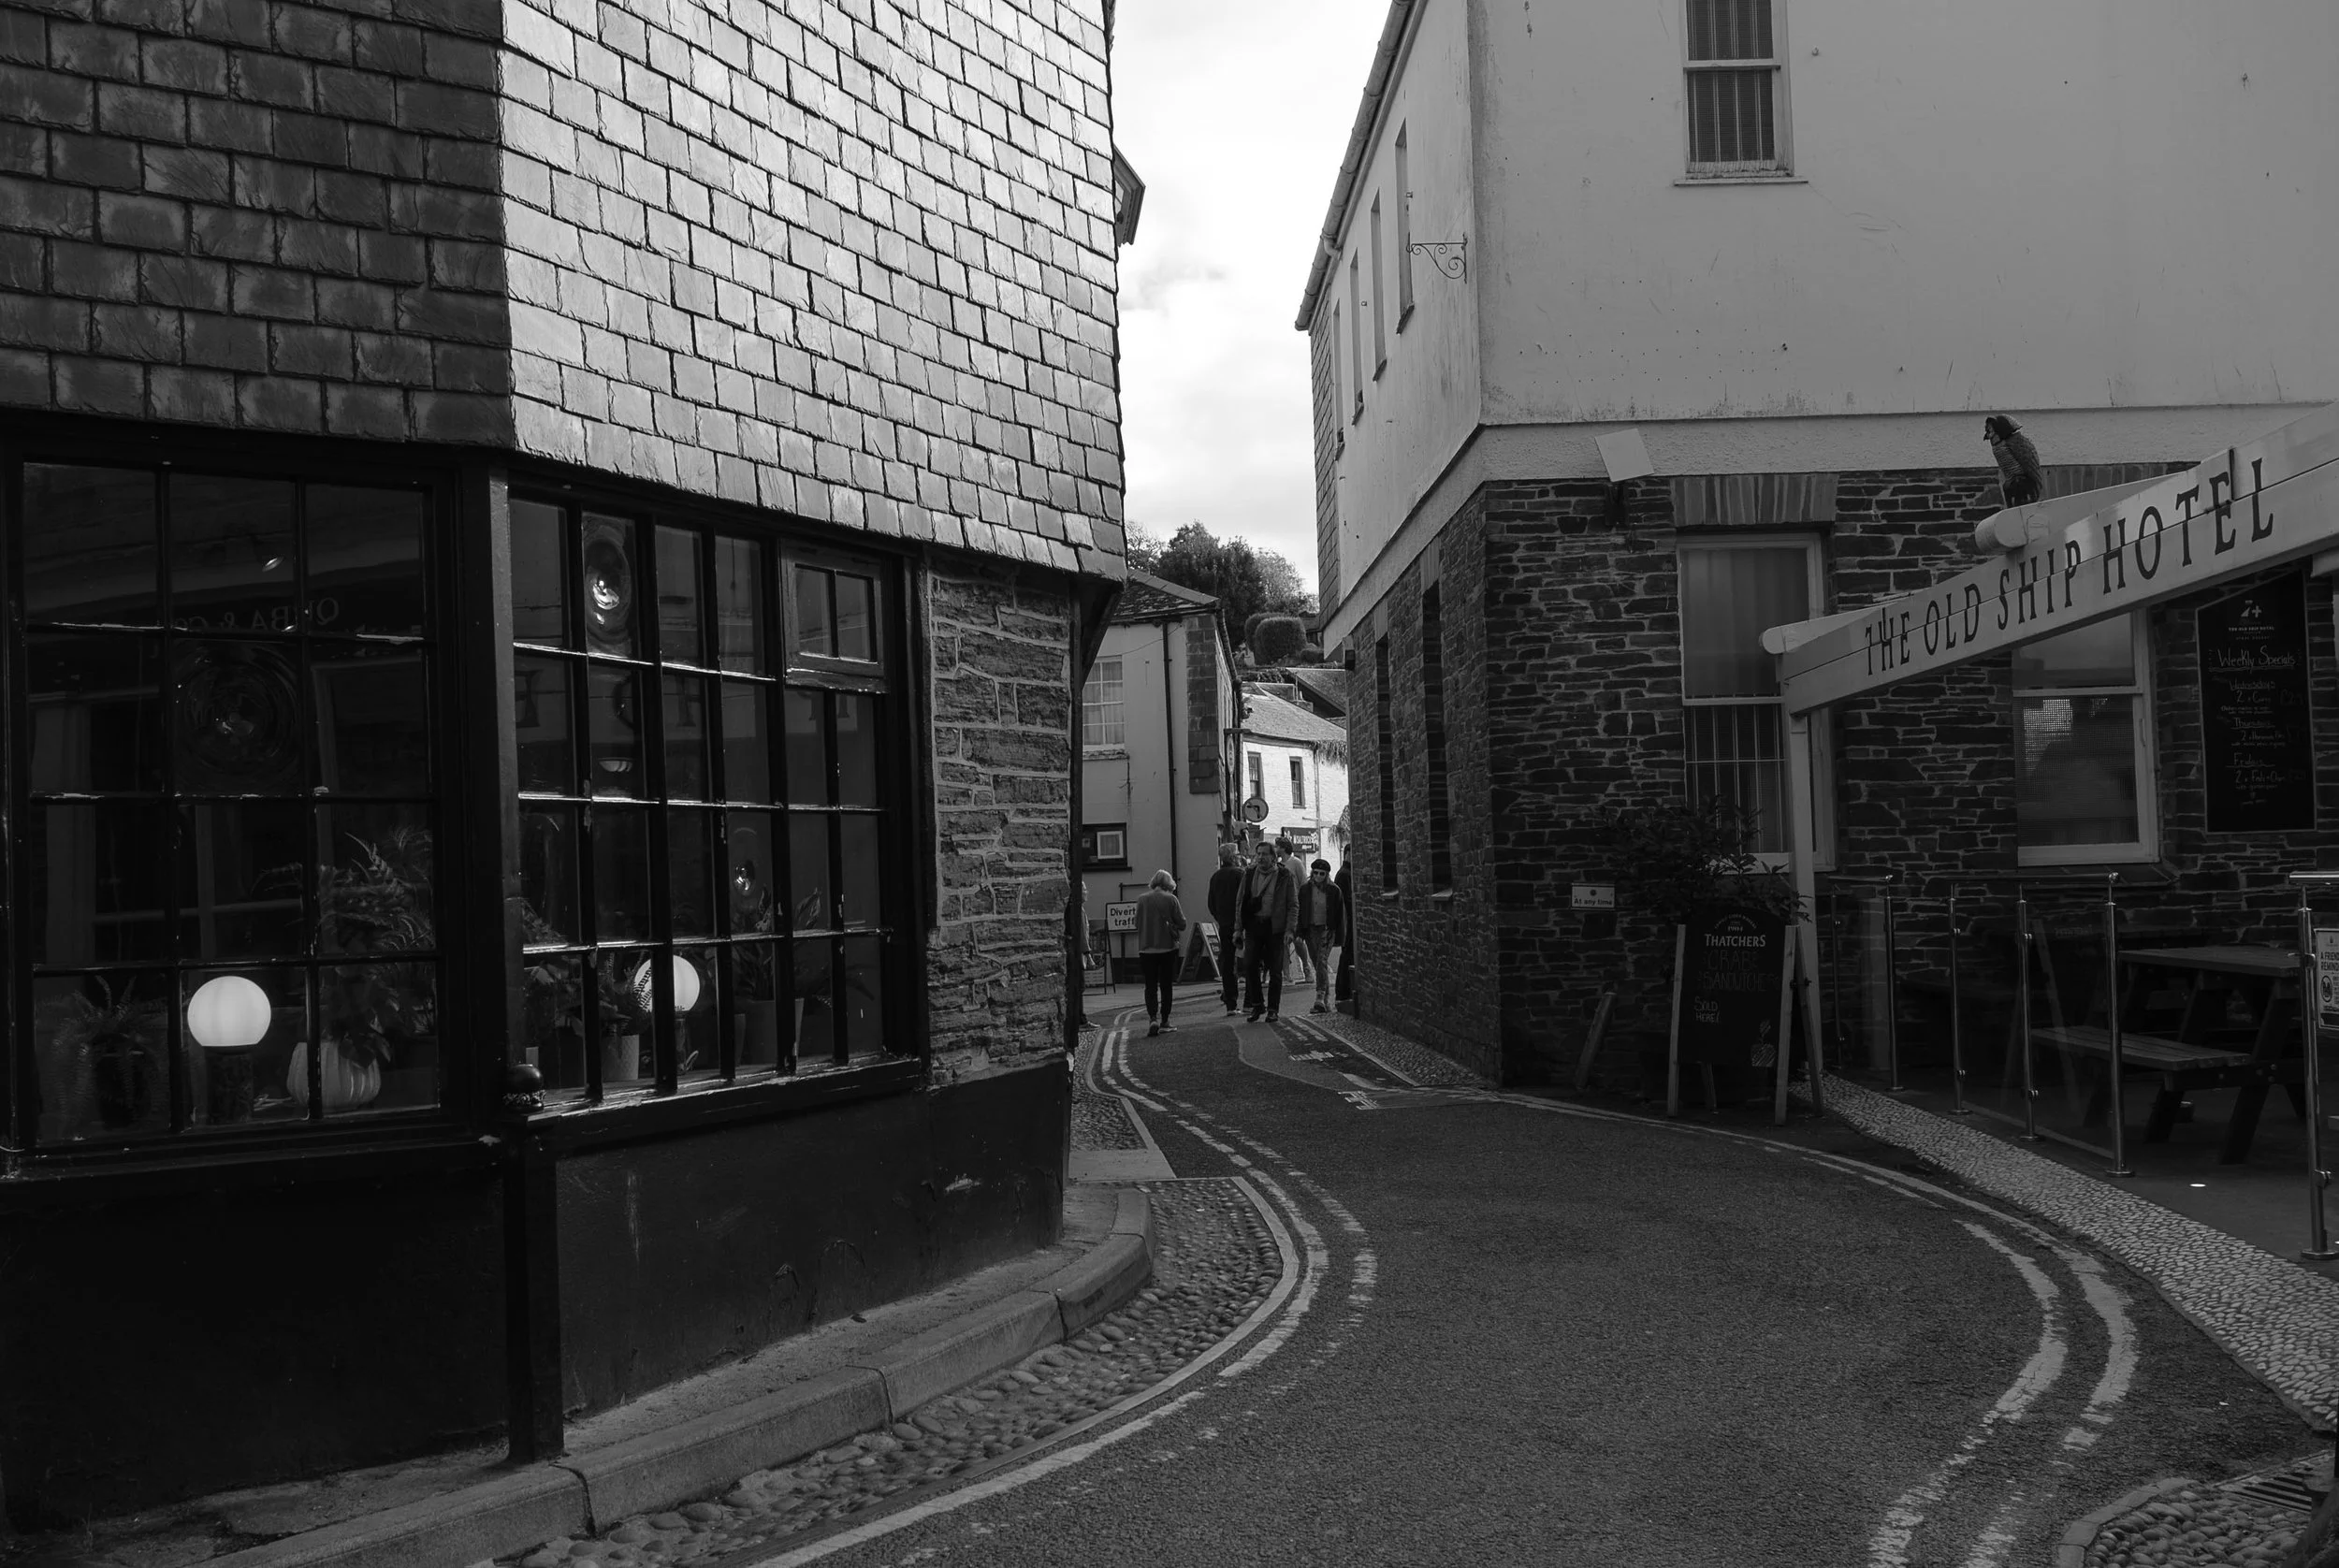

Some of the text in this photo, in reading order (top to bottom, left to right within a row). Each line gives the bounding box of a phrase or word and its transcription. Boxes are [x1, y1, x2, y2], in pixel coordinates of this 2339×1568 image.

[1865, 457, 2274, 675] THE OLD SHIP HOTEL
[2259, 645, 2296, 667] Specials
[1111, 907, 1136, 916] Divert
[1704, 934, 1766, 948] THATCHERS
